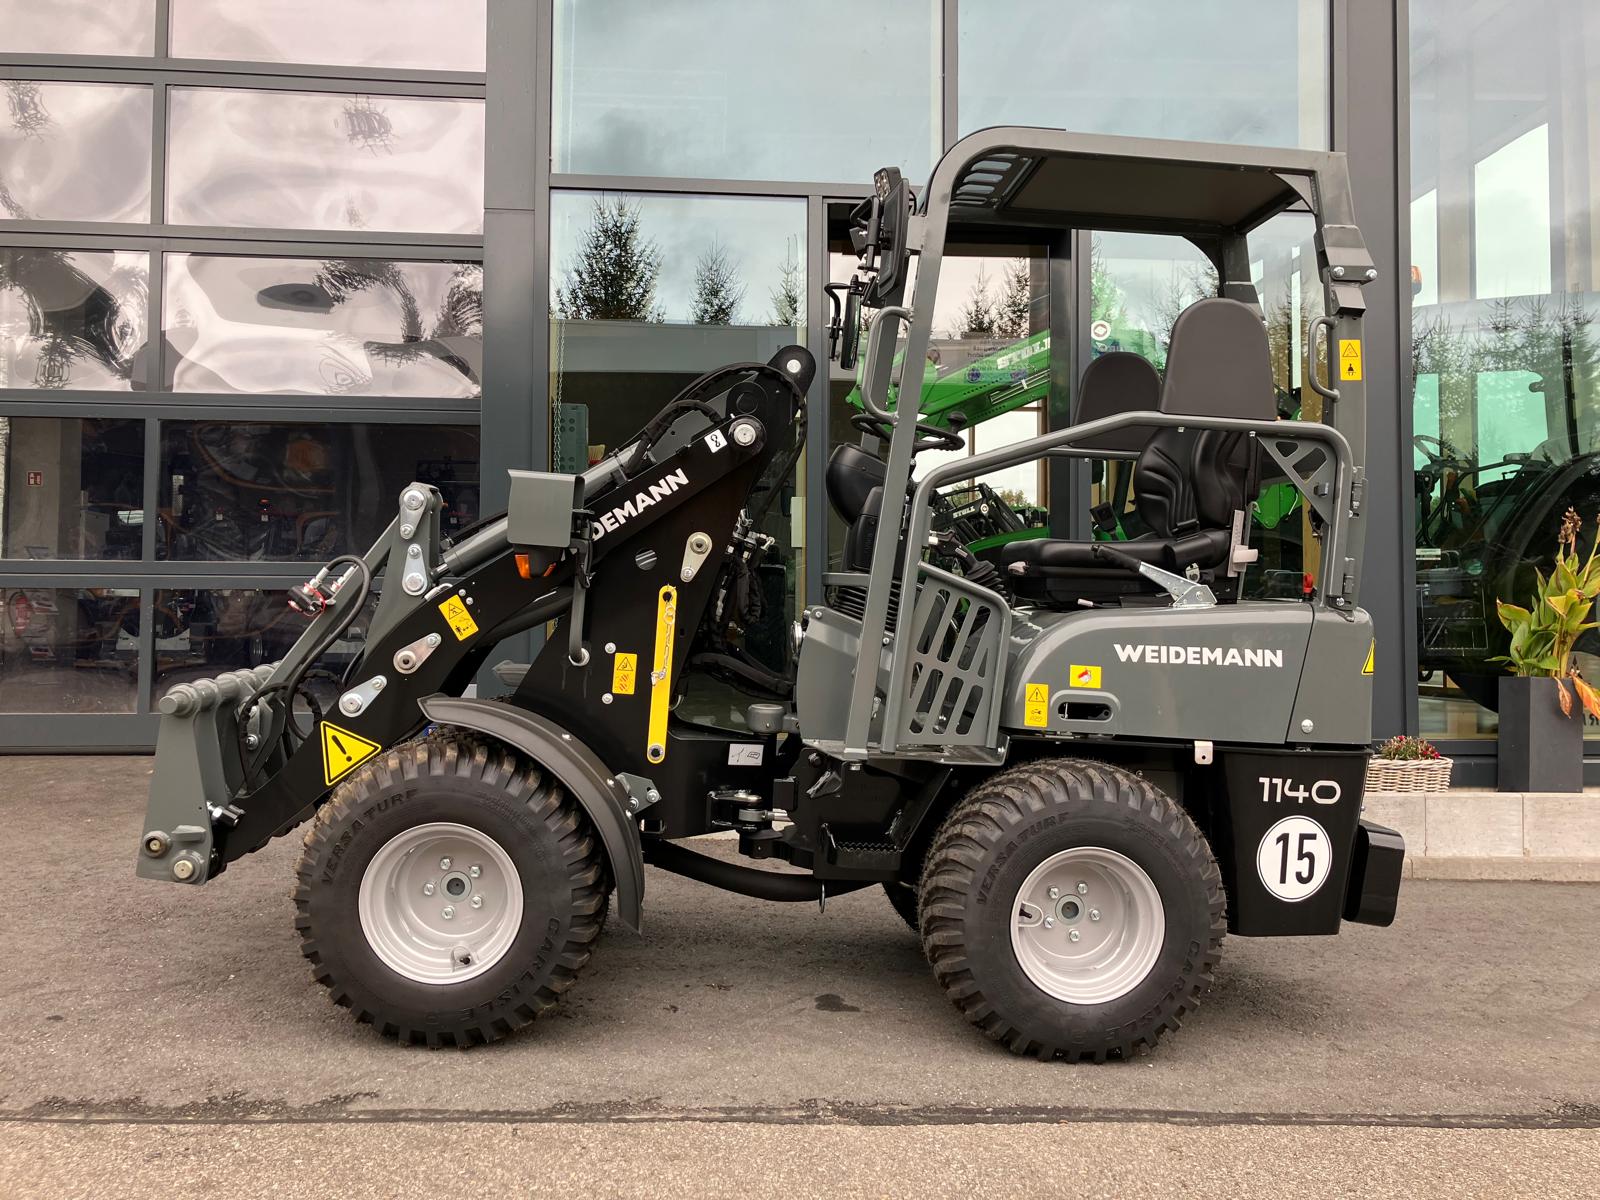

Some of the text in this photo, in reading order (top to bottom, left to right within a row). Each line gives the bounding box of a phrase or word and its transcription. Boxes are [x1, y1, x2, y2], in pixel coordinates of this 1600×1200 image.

[592, 467, 690, 541] DEMANN
[1113, 643, 1283, 668] WEIDEMANN
[363, 788, 418, 817] TURF
[1259, 776, 1341, 805] 1140
[1017, 812, 1069, 841] TURF
[1274, 832, 1318, 885] 15
